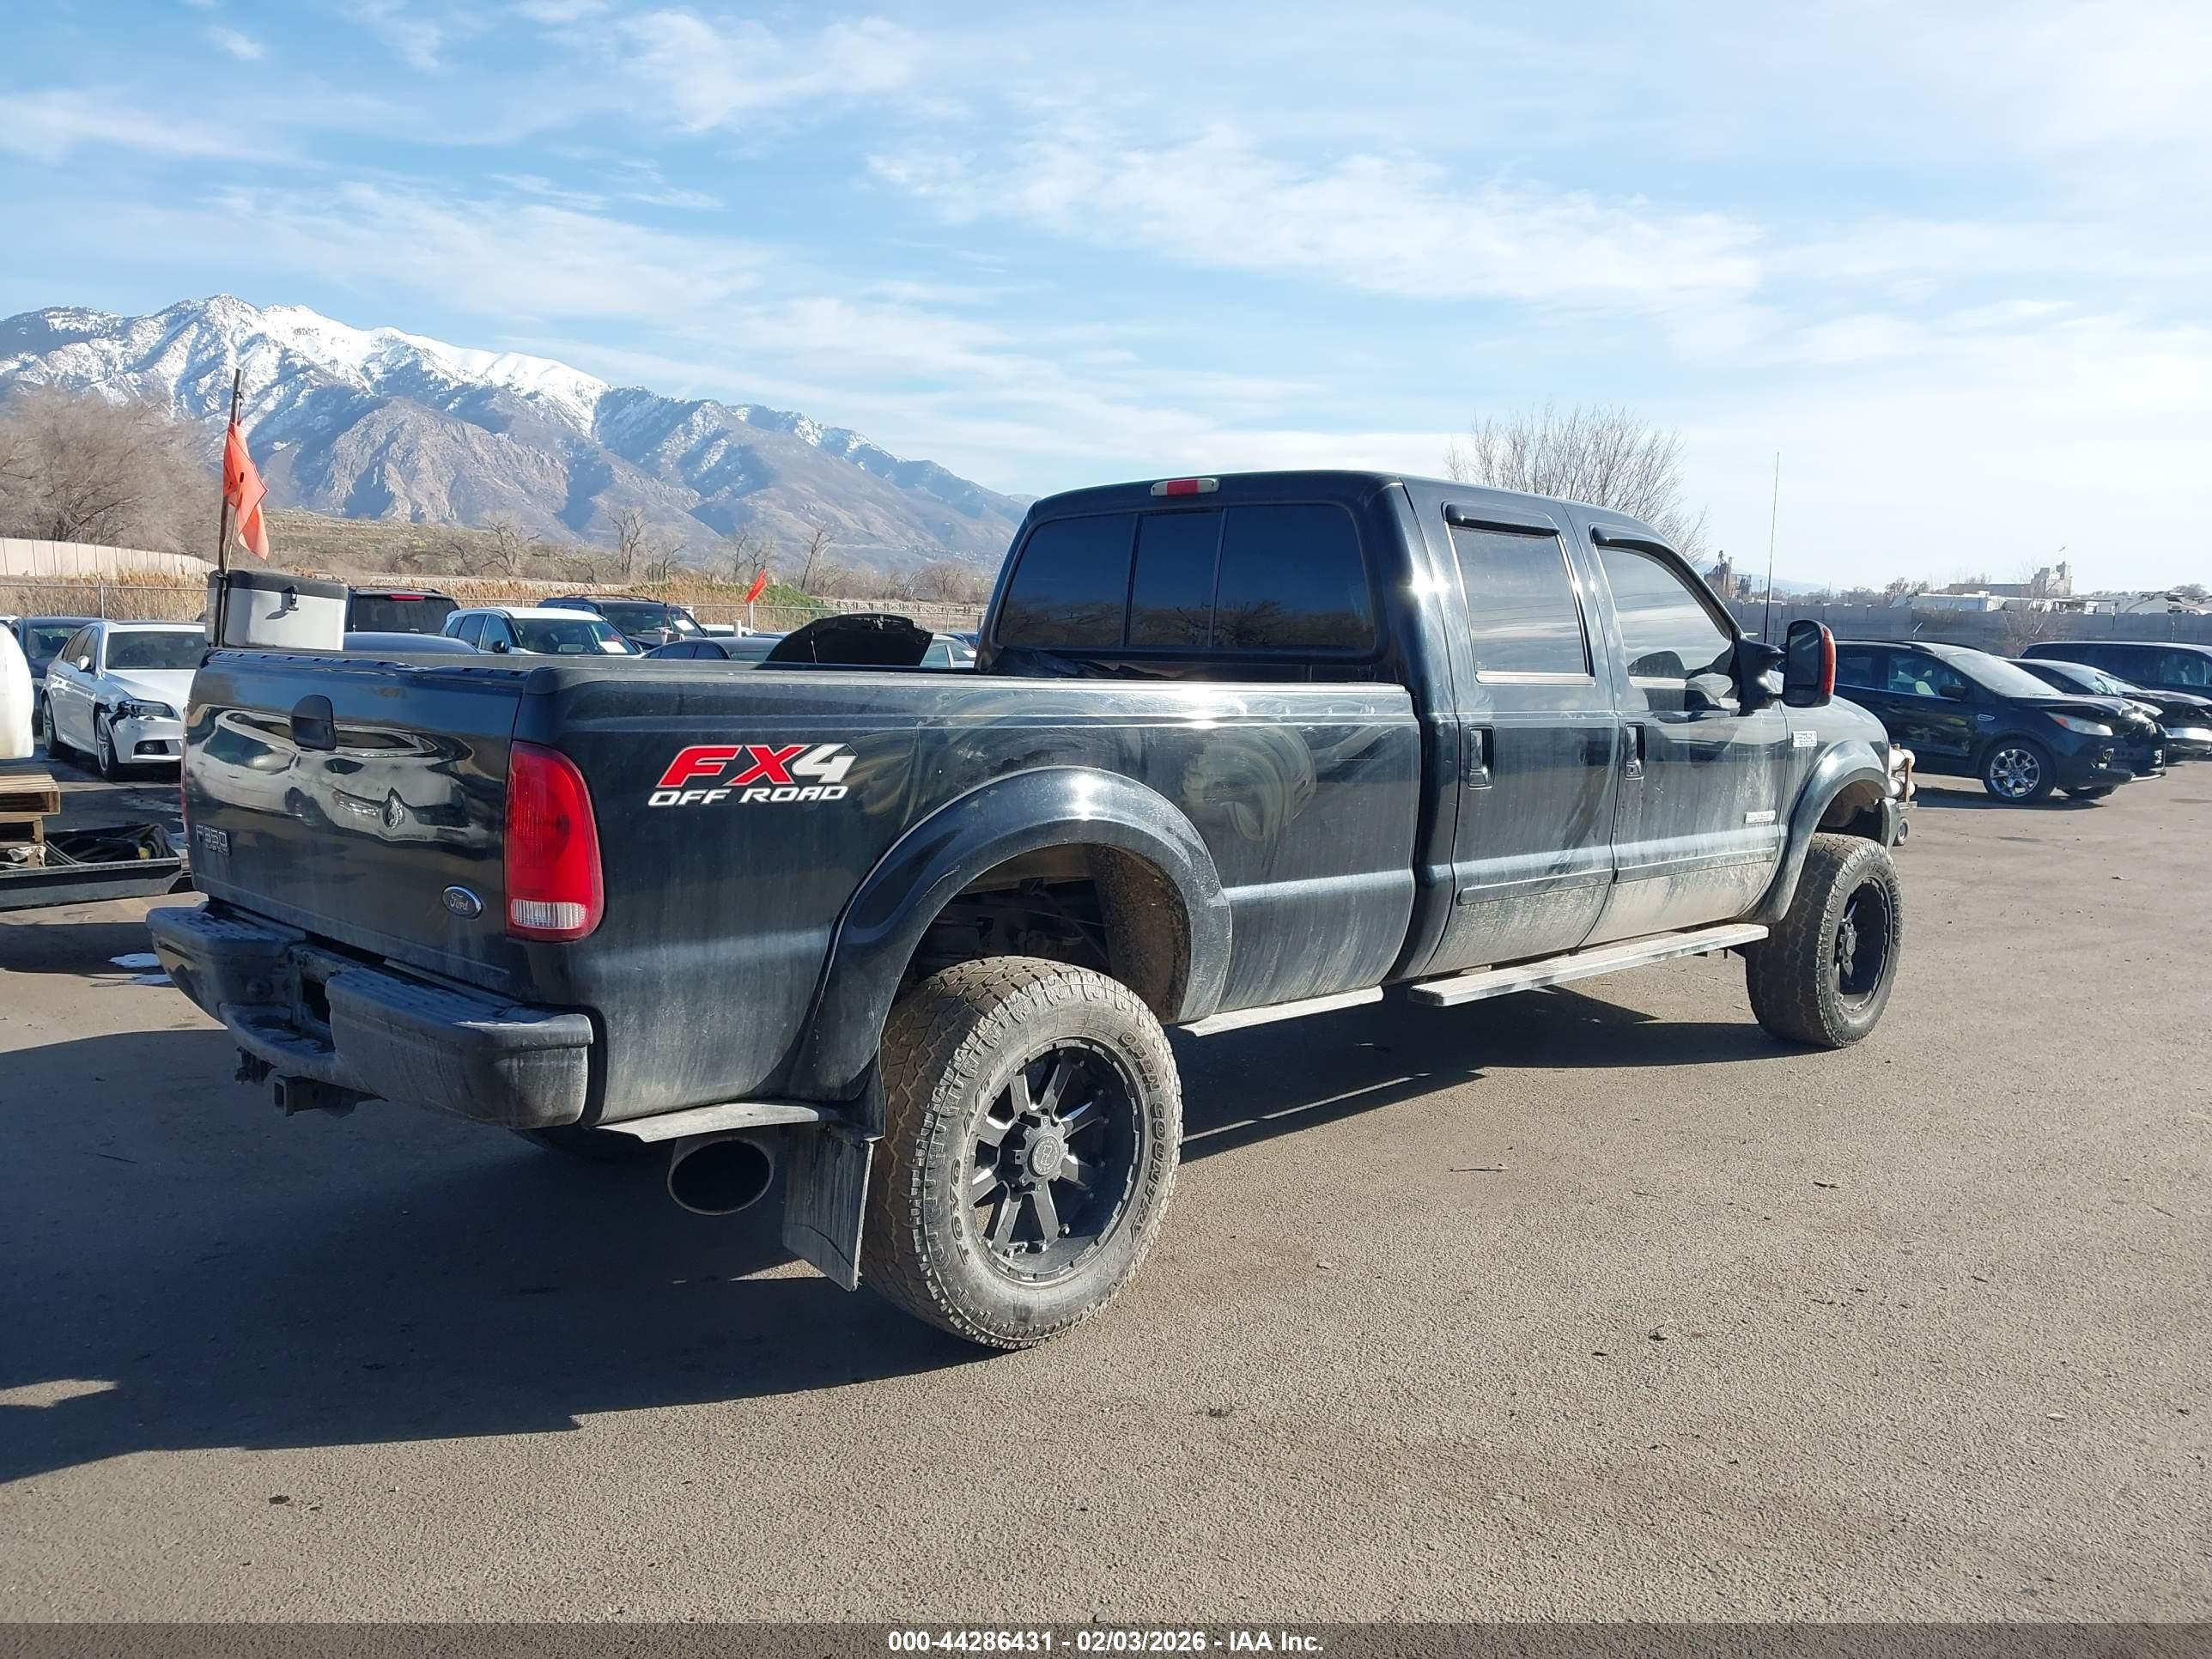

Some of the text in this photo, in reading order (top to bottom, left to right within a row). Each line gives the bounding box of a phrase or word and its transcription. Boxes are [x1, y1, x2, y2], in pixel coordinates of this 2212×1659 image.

[647, 786, 848, 807] OFF ROAD
[655, 743, 858, 788] FX4
[1118, 1032, 1166, 1243] OPEN COUNTRY
[949, 1159, 969, 1265] TOYO
